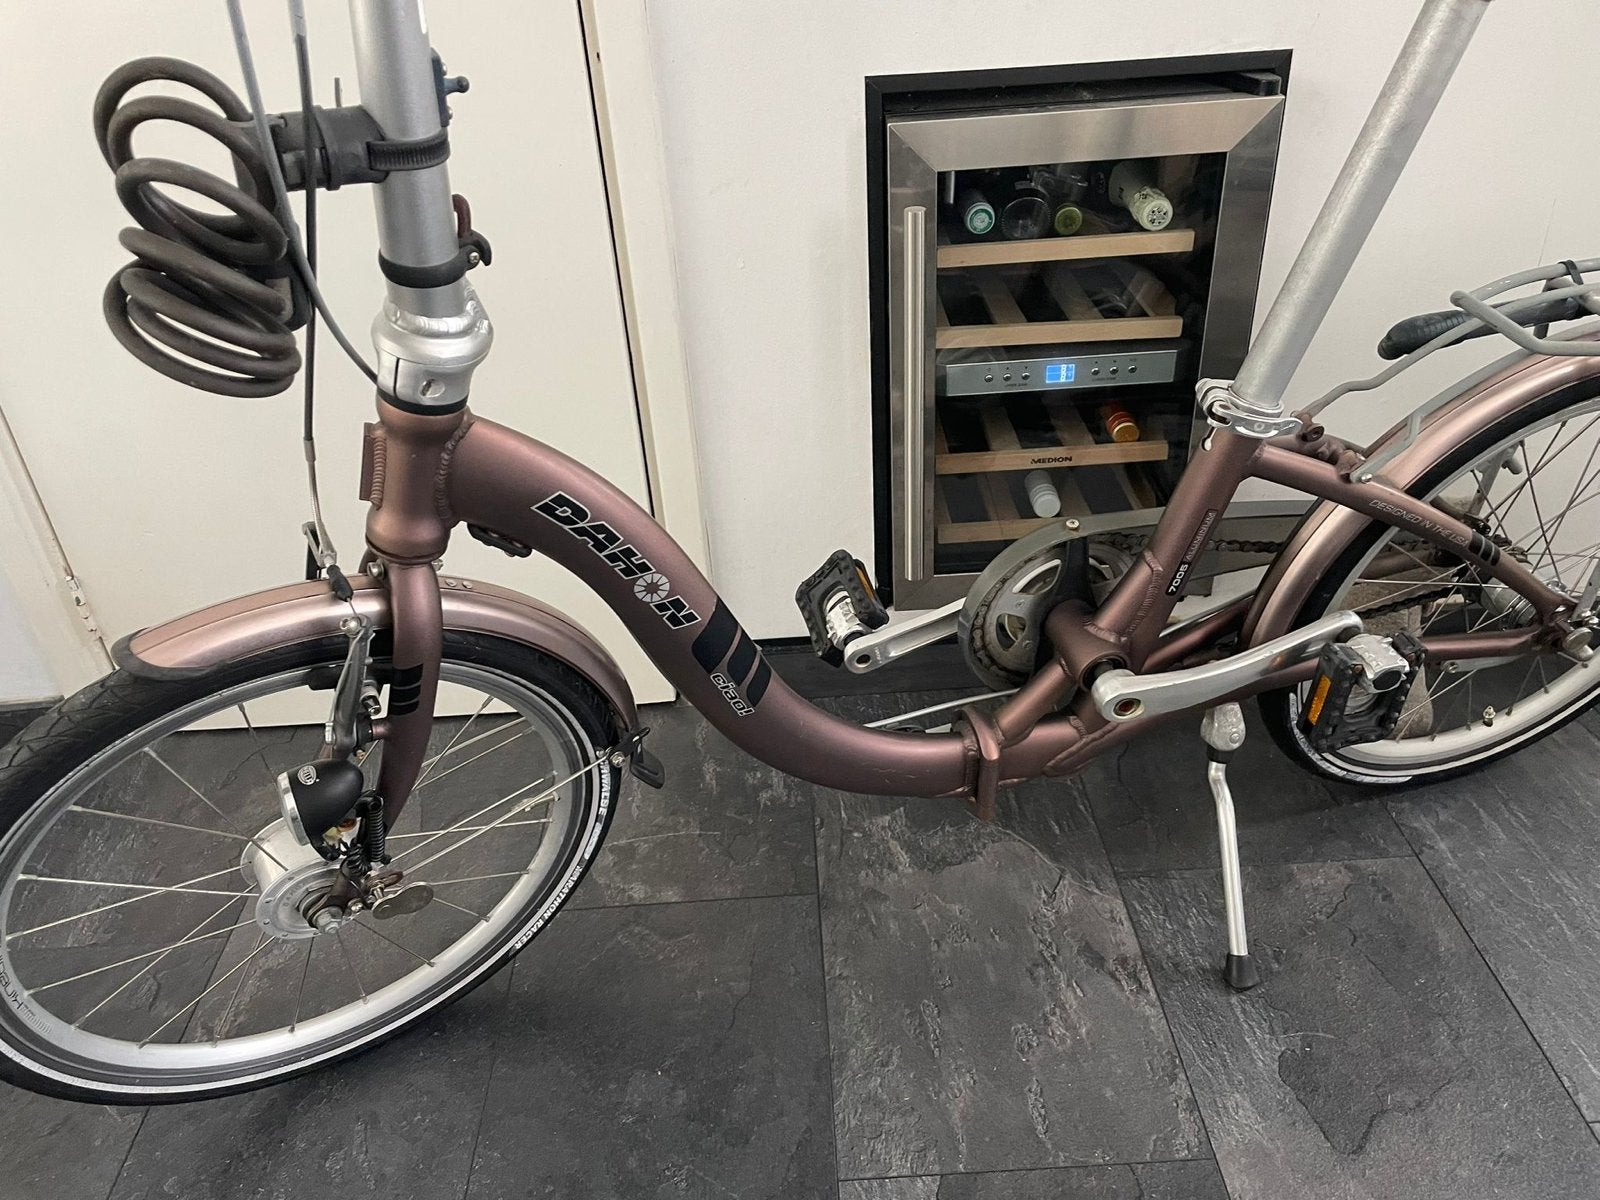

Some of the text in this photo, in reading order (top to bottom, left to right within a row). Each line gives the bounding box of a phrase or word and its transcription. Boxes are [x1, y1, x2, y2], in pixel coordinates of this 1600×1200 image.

[1030, 455, 1073, 465] MEDION
[1368, 499, 1423, 524] DESIGNED
[1419, 519, 1433, 530] IN
[1431, 524, 1452, 538] THE
[530, 490, 702, 630] DAHON
[1168, 511, 1217, 593] 7005 ALUMINUM
[709, 672, 755, 717] ciao!
[514, 865, 585, 950] MARATHON RACER
